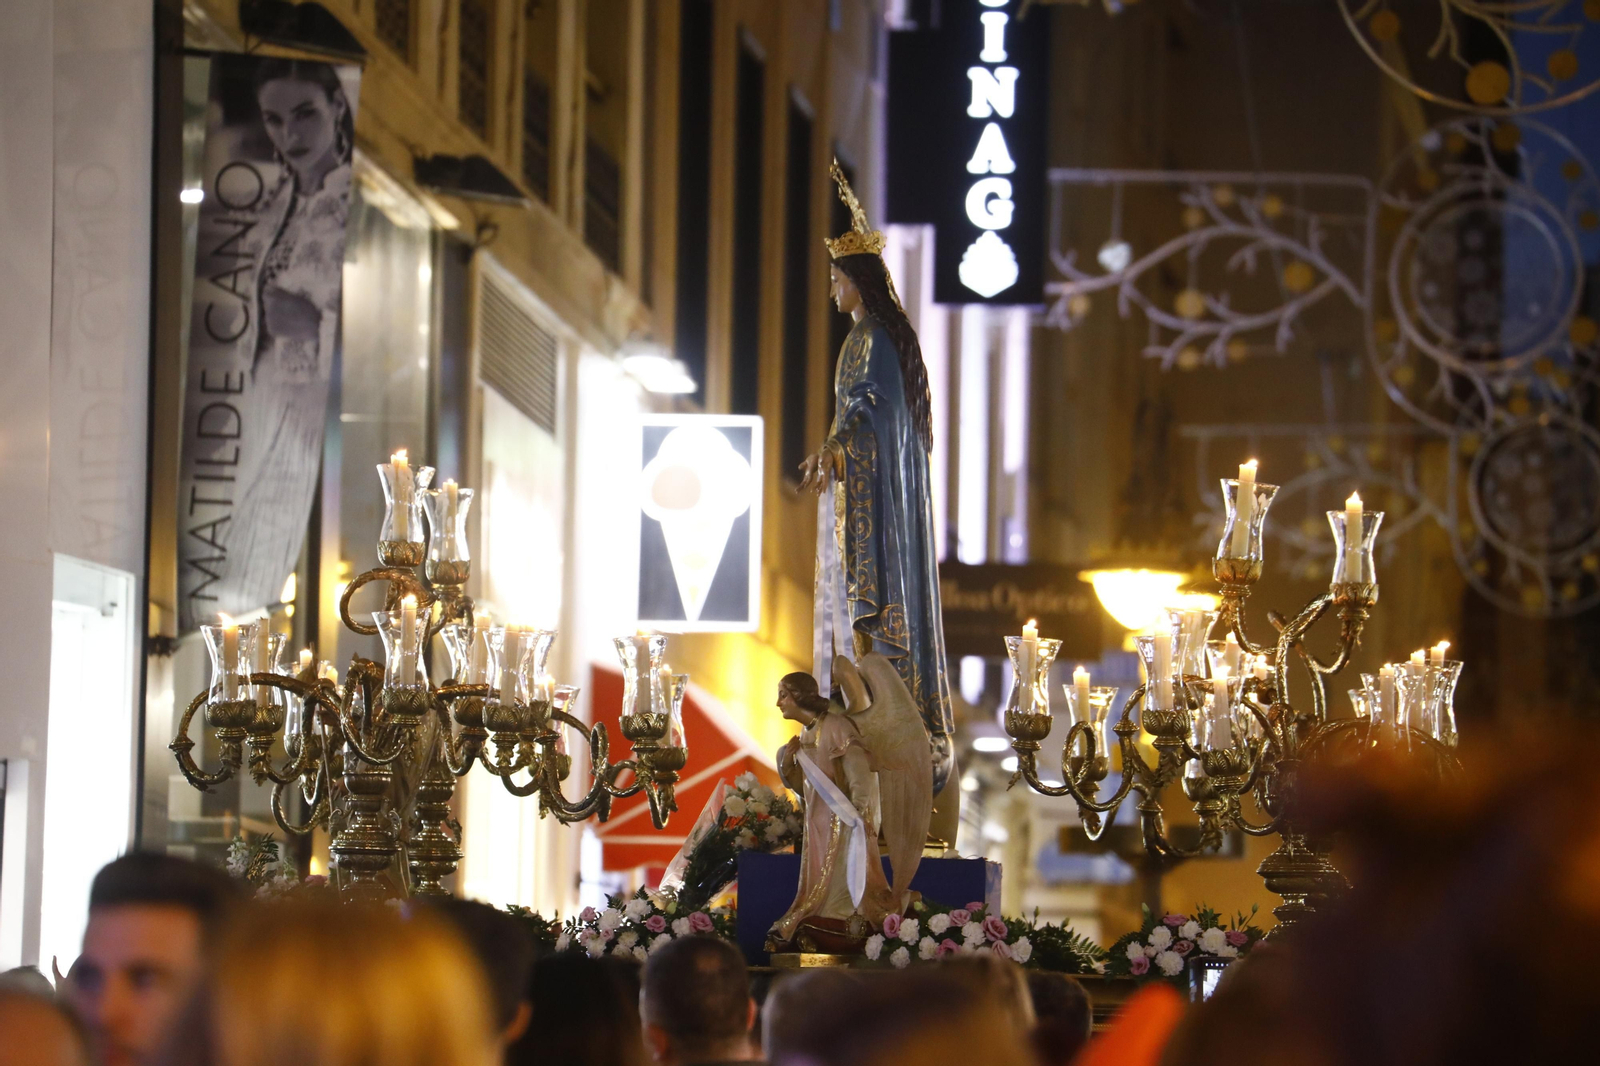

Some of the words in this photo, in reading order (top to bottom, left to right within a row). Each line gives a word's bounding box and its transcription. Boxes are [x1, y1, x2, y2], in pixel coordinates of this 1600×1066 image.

[965, 0, 1019, 230] INAG
[206, 162, 264, 343] CANO
[185, 370, 244, 602] MATILDE
